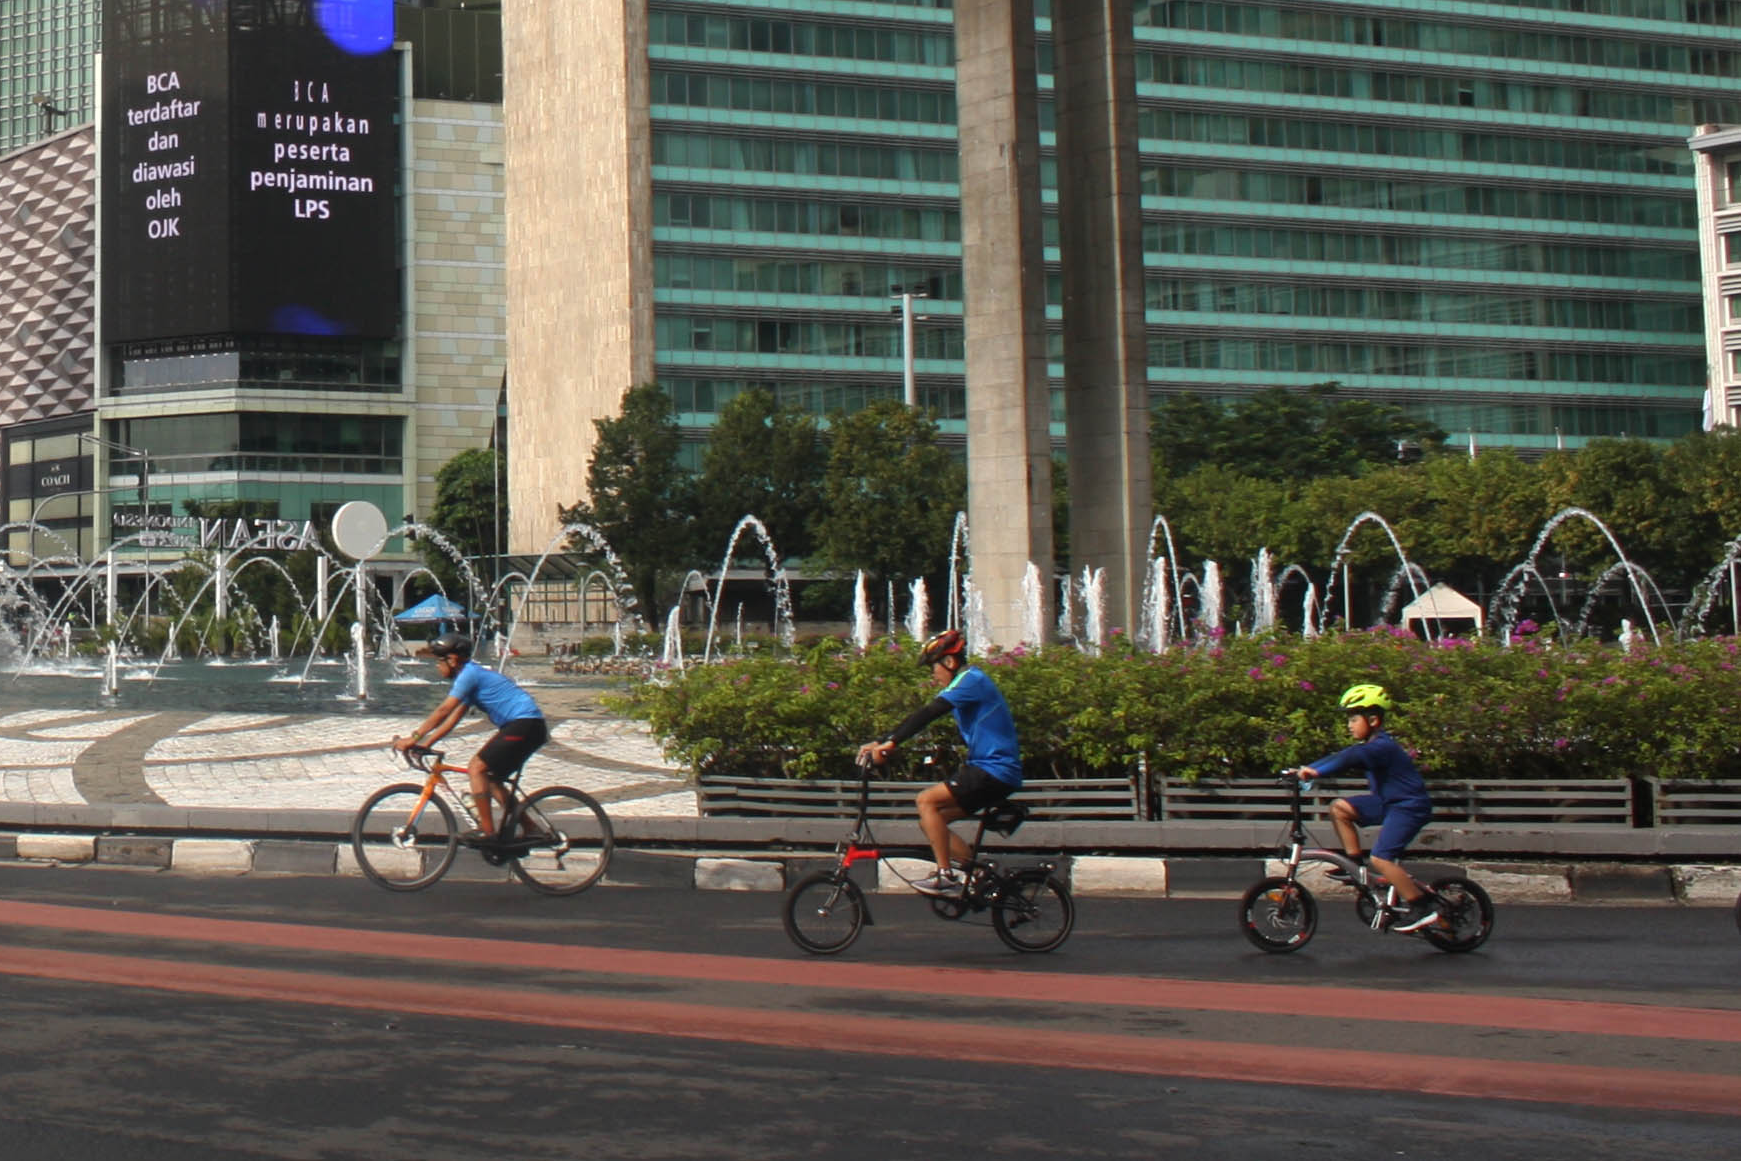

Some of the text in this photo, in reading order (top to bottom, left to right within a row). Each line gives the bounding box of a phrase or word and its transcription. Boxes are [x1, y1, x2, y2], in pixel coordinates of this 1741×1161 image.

[147, 71, 180, 94] BCA
[127, 99, 201, 126] terdaftar
[257, 111, 369, 137] merupakan
[148, 131, 179, 152] dan
[274, 142, 350, 163] peserta
[132, 155, 195, 183] diawasi
[250, 168, 373, 193] penjaminan
[146, 187, 181, 210] oleh
[294, 199, 330, 219] LPS
[148, 217, 180, 239] OJK
[41, 473, 71, 487] COACH
